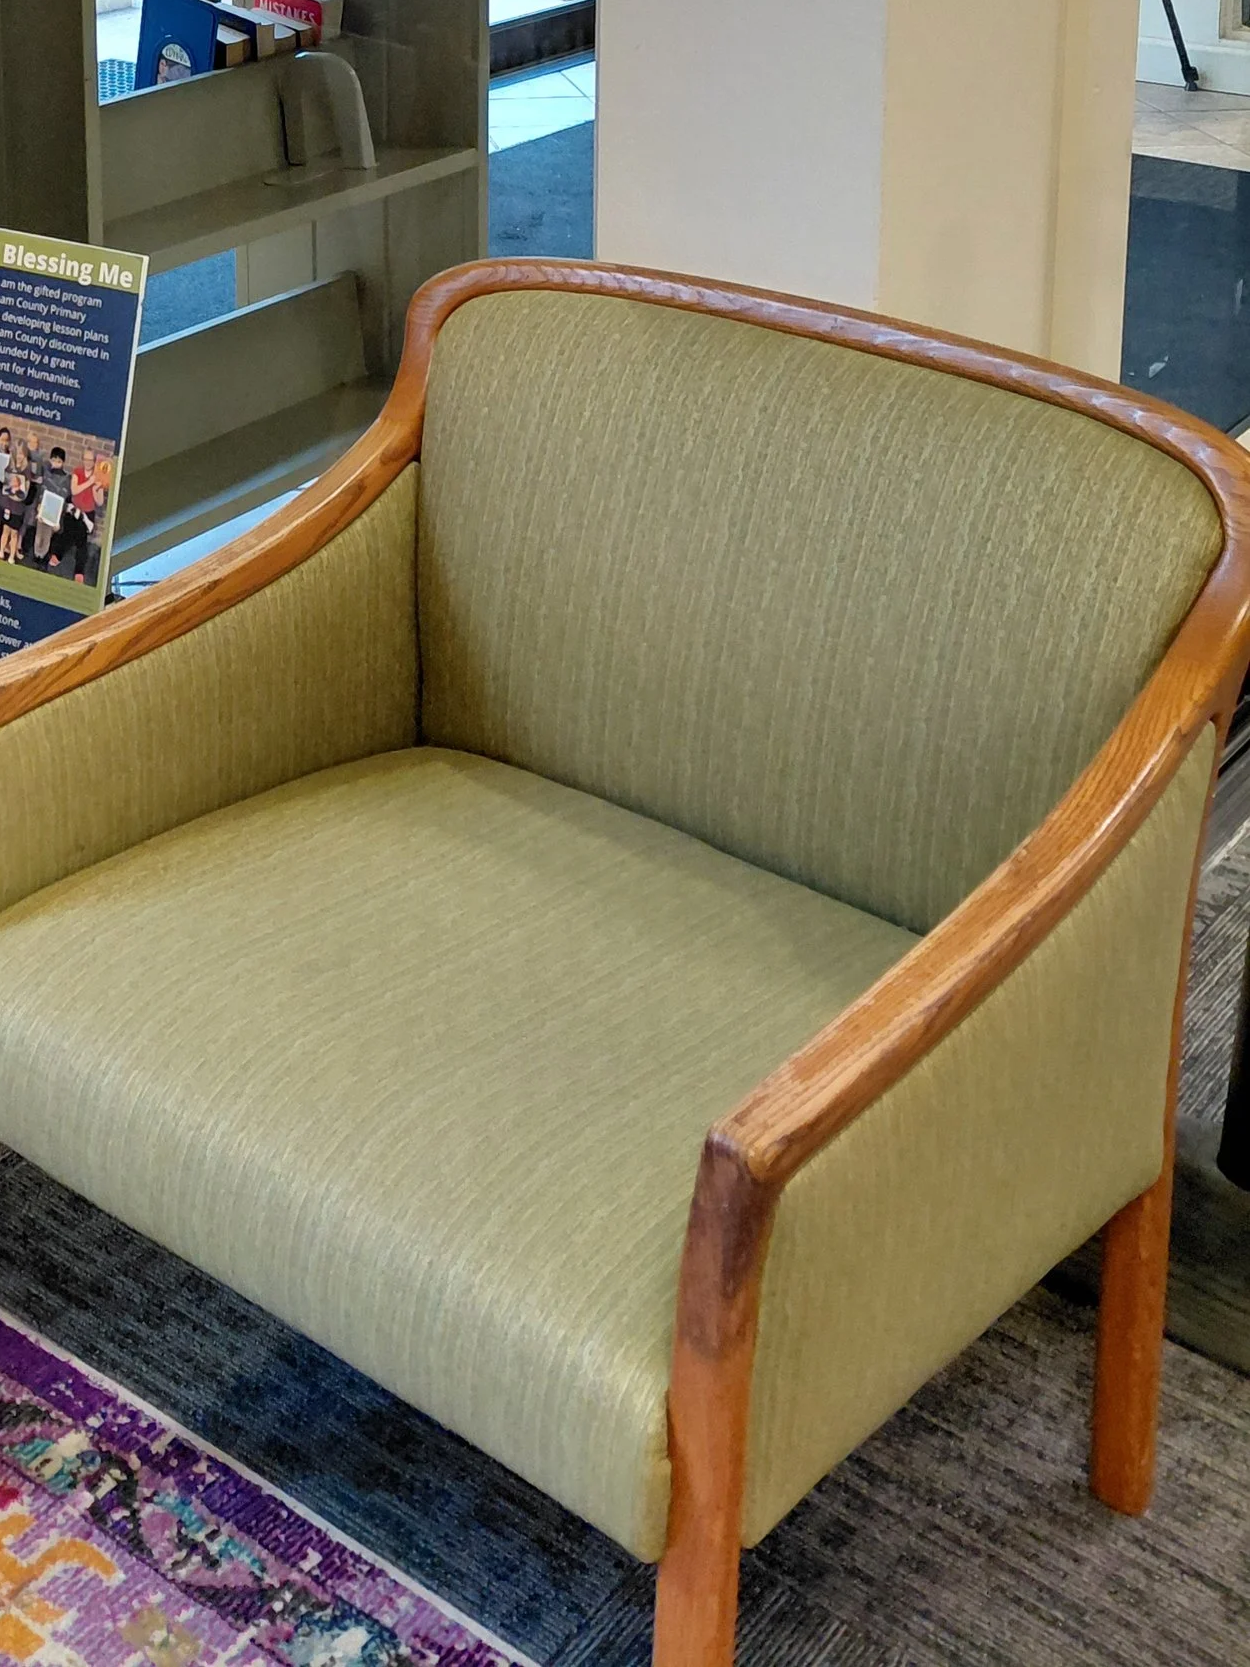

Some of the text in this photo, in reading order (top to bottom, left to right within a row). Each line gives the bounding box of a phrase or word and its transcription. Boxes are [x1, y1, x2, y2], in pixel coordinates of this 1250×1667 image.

[3, 244, 94, 285] Blessing
[98, 262, 134, 288] Me
[1, 279, 15, 290] am
[17, 281, 32, 293] the
[33, 285, 61, 299] gifted
[62, 292, 102, 308] program
[16, 298, 48, 315] County
[50, 305, 86, 324] Primary
